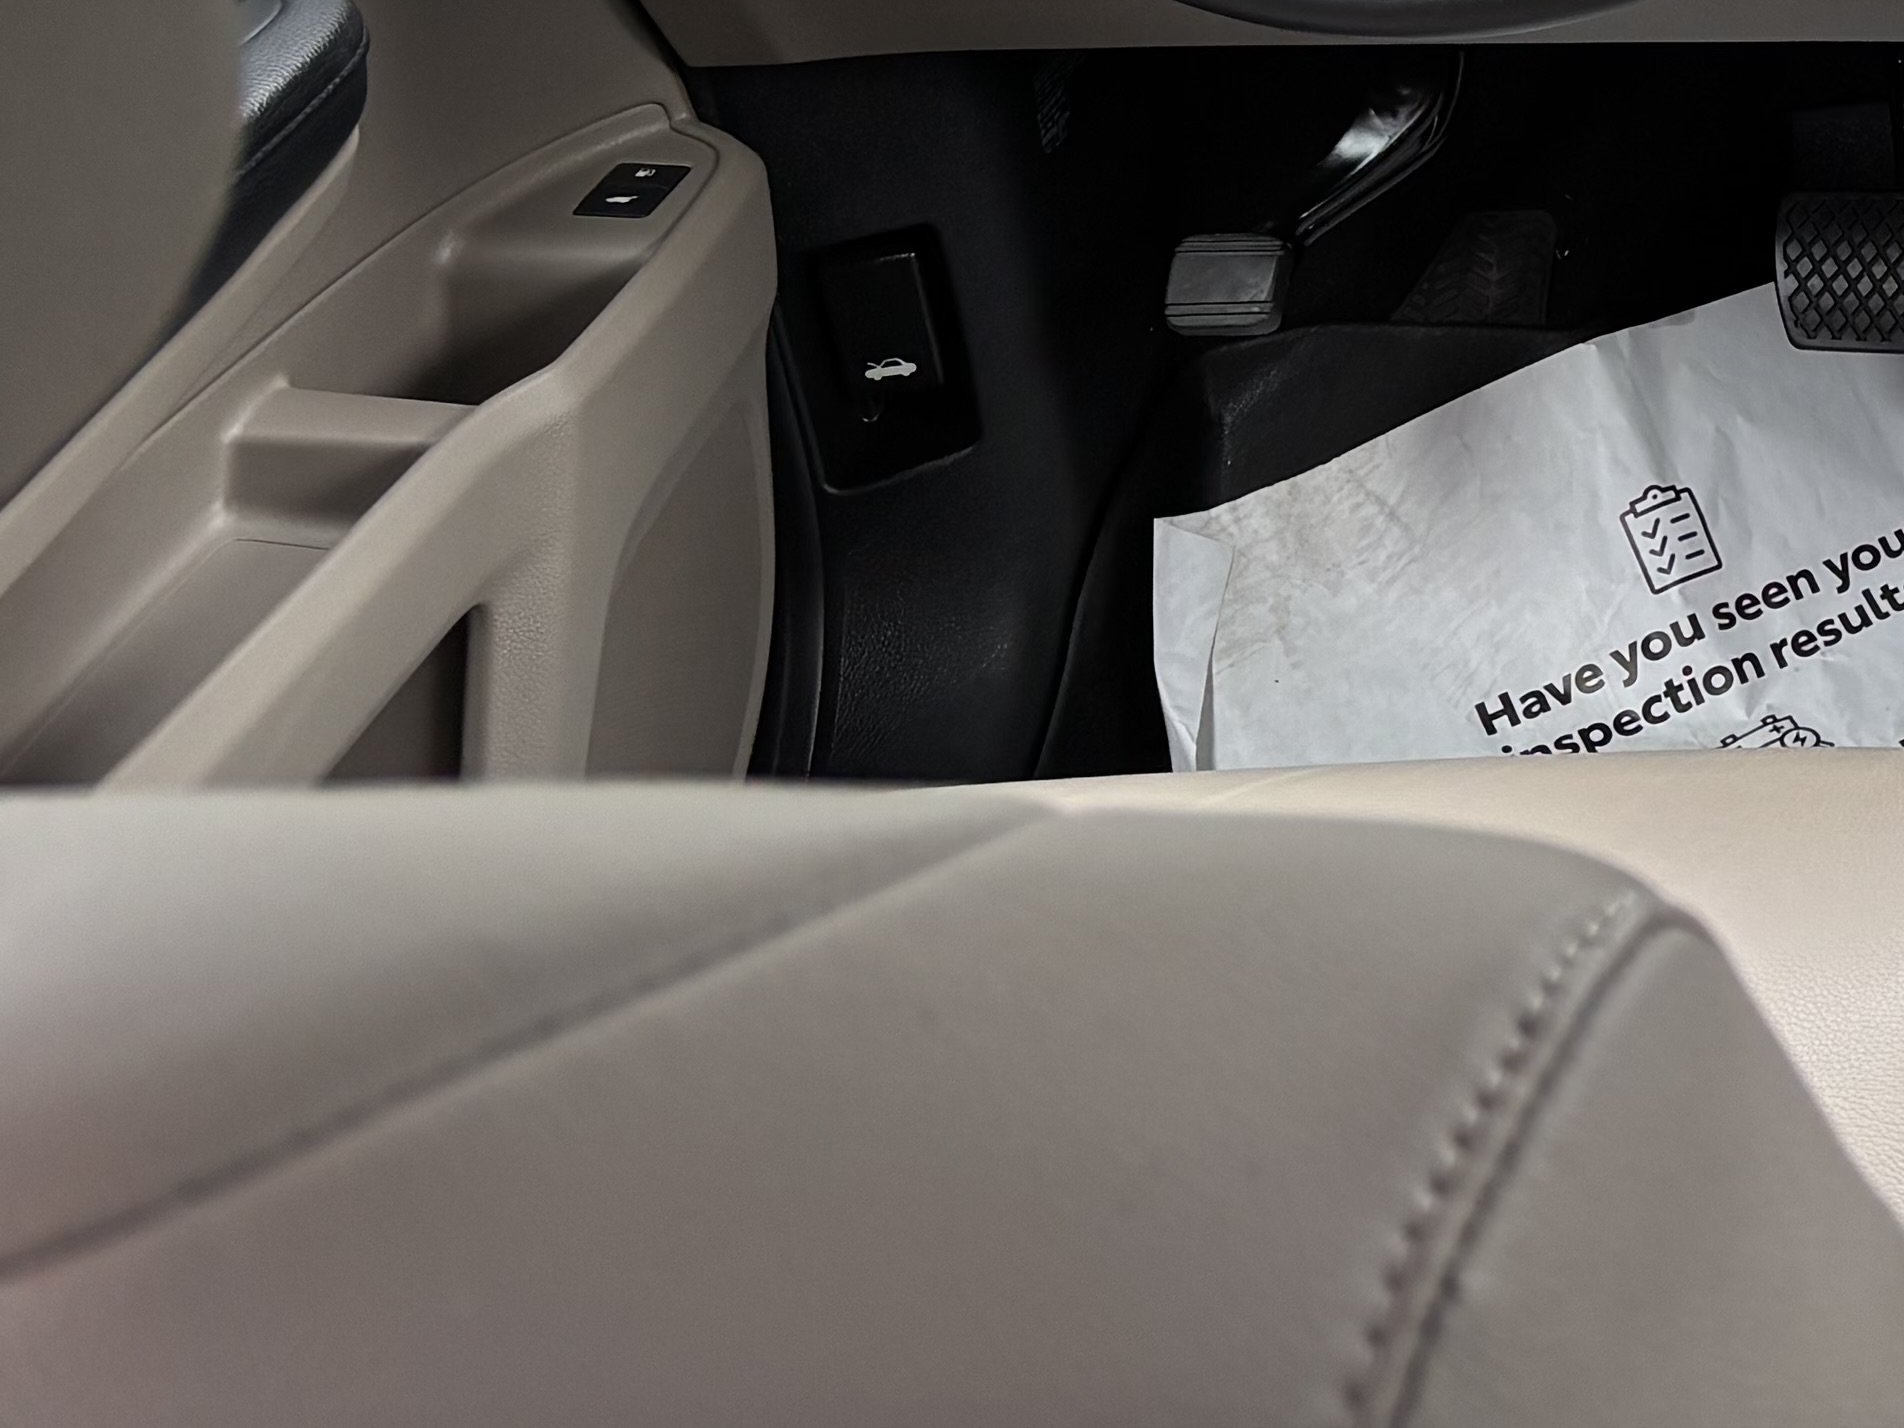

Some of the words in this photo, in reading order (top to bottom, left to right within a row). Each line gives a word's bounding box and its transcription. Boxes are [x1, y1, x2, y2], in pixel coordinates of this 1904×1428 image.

[1474, 660, 1604, 738] Have
[1608, 614, 1706, 692] you
[1710, 566, 1819, 632] seen
[1501, 648, 1767, 755] spection
